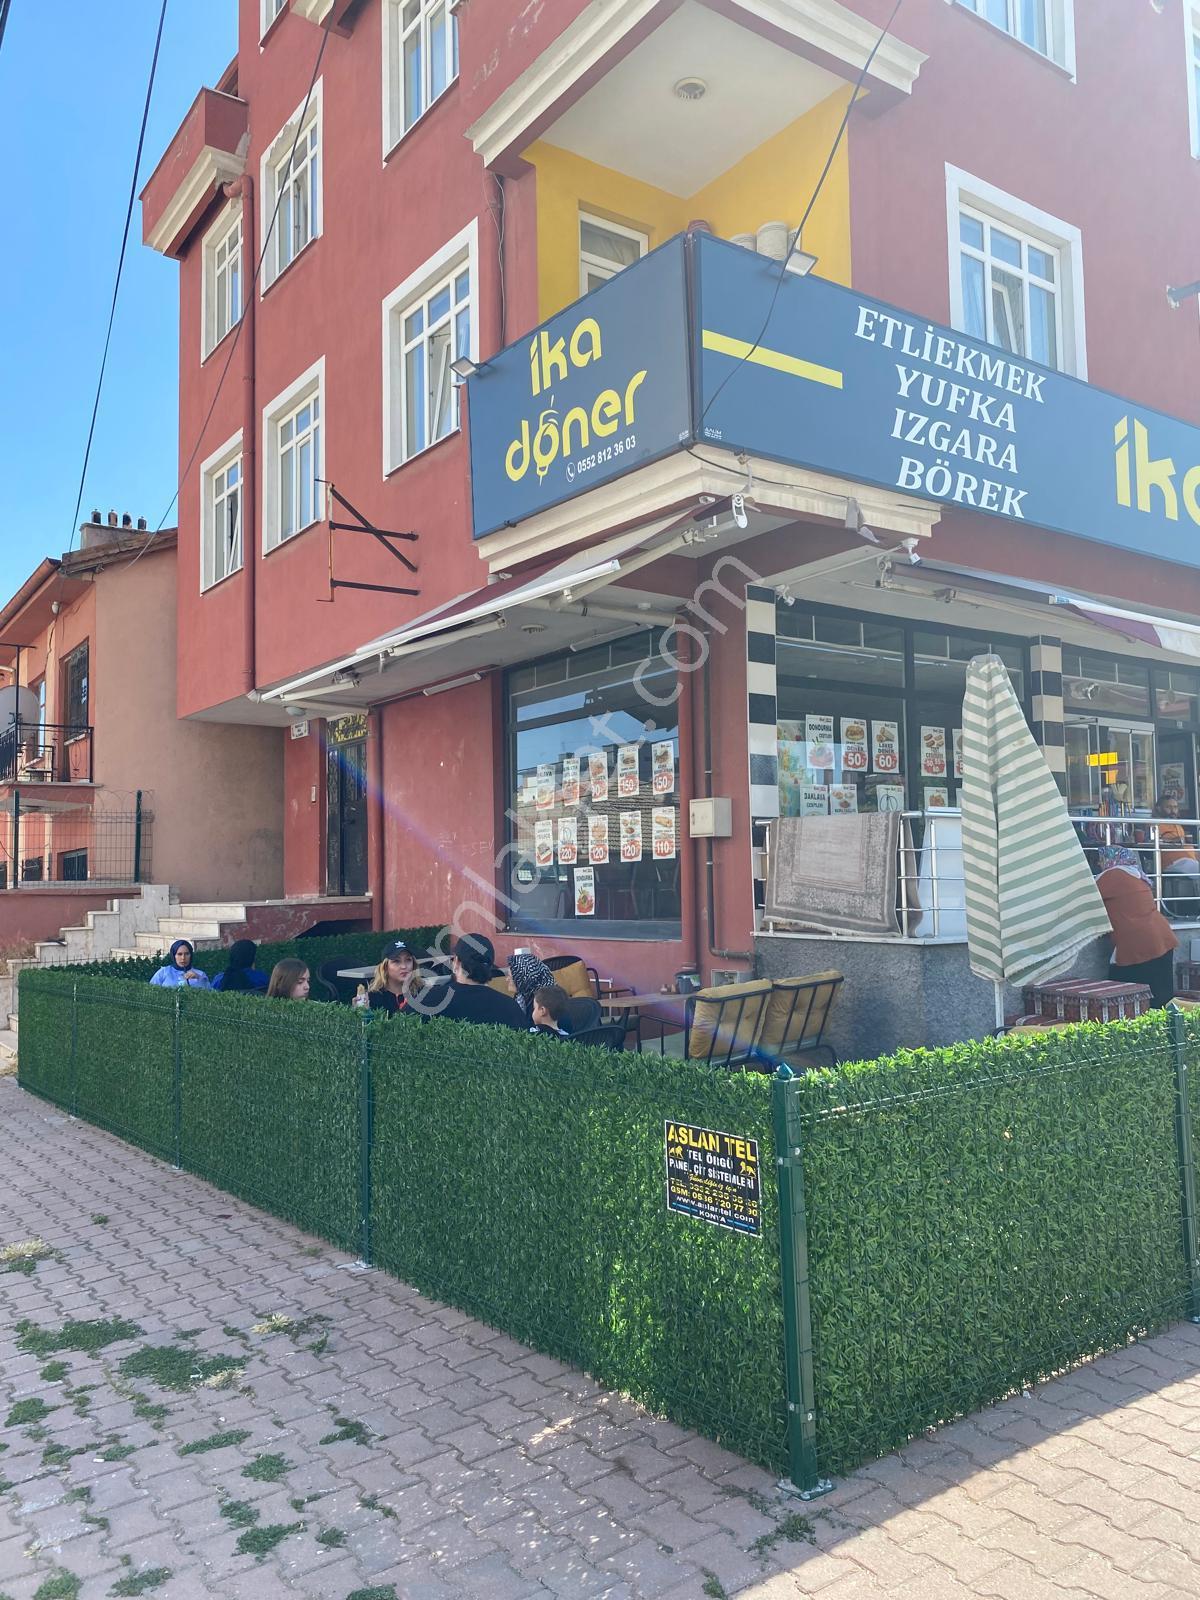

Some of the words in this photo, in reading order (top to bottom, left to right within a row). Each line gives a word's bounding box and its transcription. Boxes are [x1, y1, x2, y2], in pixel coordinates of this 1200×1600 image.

[853, 305, 1047, 404] ETLİEKMEK
[894, 364, 1018, 434] YUFKA
[505, 370, 648, 486] döner
[890, 407, 1019, 474] IZGARA
[577, 455, 596, 474] 0552
[597, 446, 612, 464] 812
[614, 441, 624, 457] 36
[625, 435, 636, 450] 03
[895, 455, 1029, 520] BÖREK
[668, 1124, 720, 1153] ASLAN
[724, 1137, 757, 1162] TEL
[687, 1148, 703, 1162] TEL
[699, 1209, 727, 1224] KONYA
[733, 1203, 745, 1213] 77
